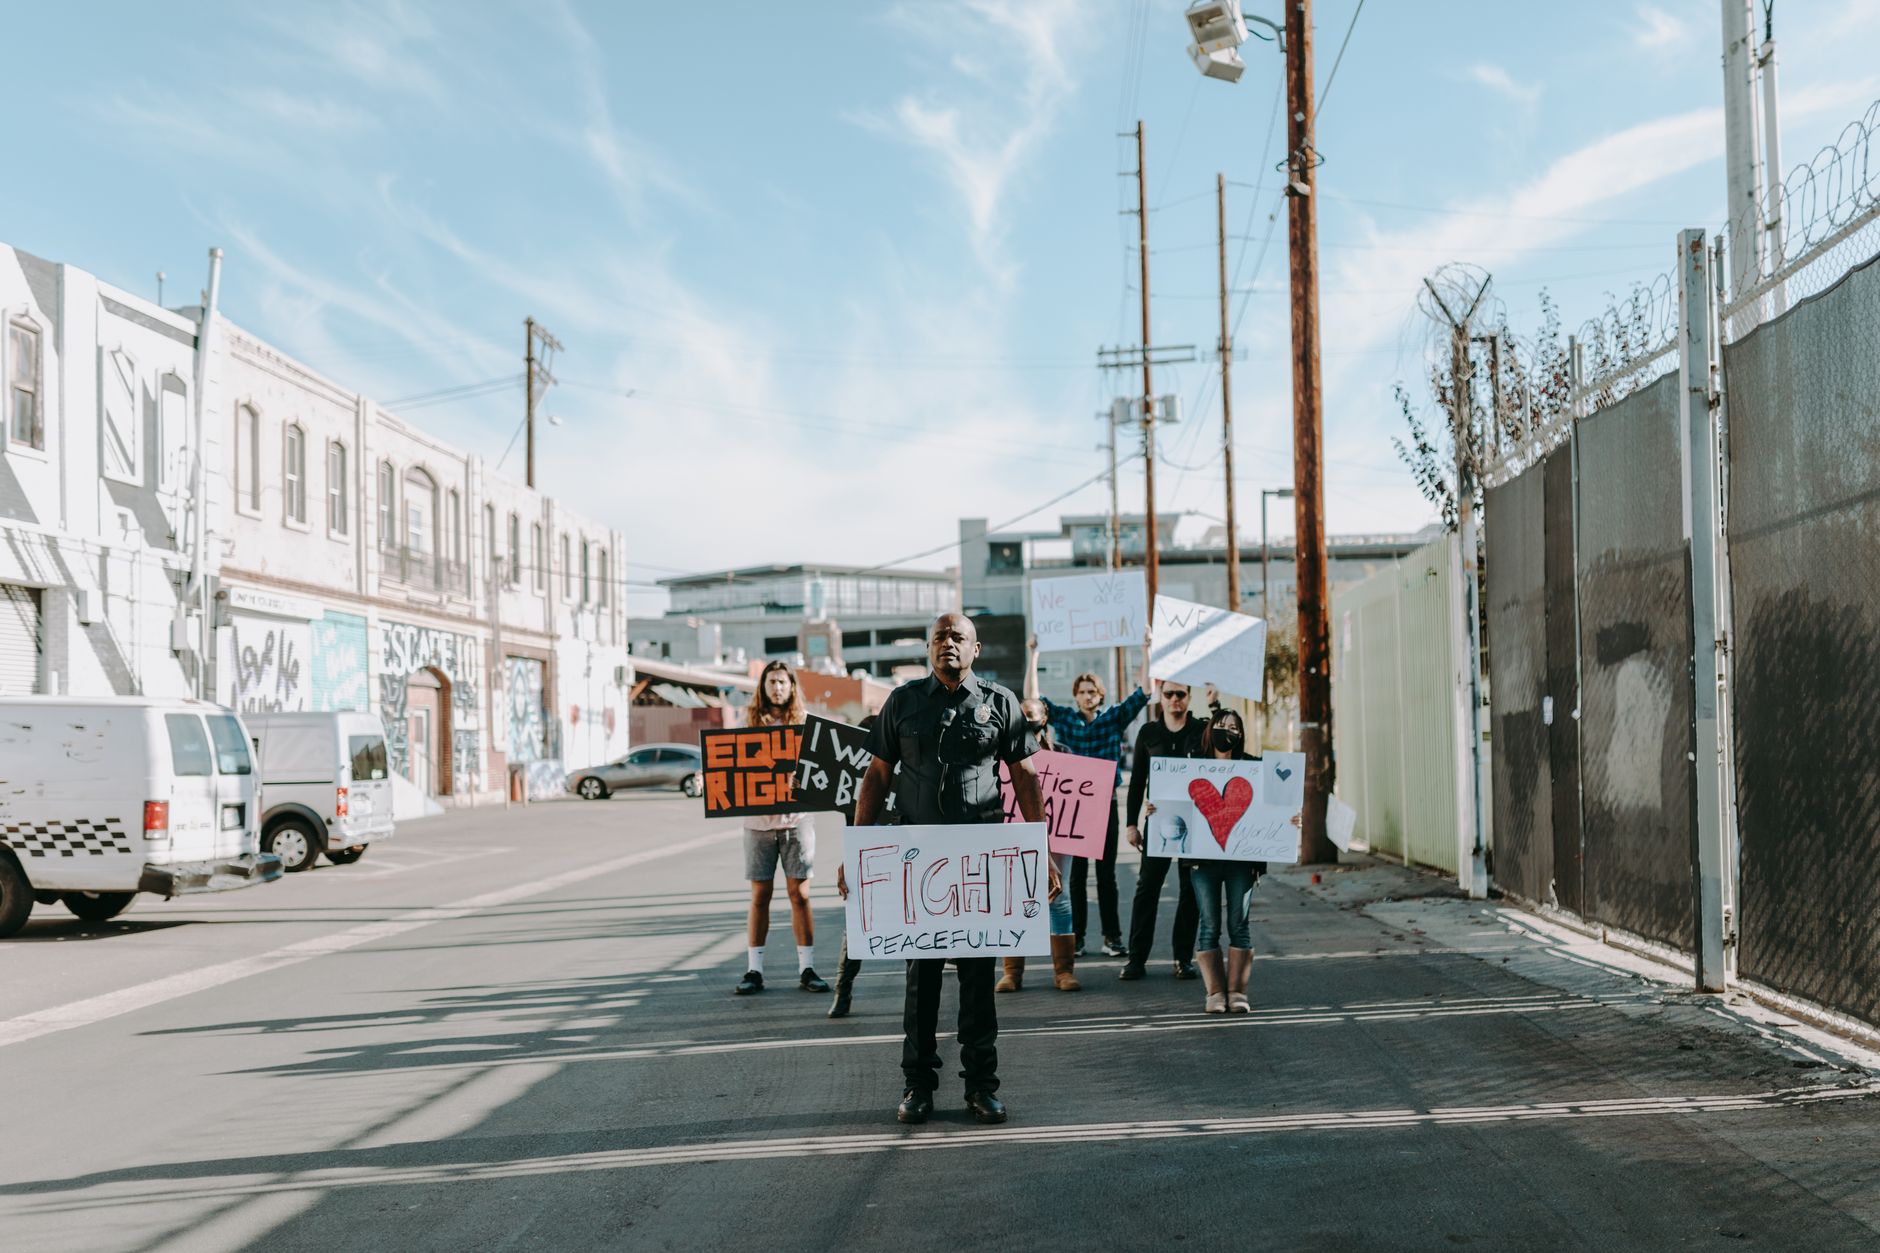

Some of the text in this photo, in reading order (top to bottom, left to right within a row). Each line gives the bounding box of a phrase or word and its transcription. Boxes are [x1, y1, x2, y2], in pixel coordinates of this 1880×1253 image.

[1036, 583, 1065, 610] We
[1037, 619, 1064, 634] are
[705, 729, 802, 769] EQU
[868, 929, 1027, 956] PEACEFULLY
